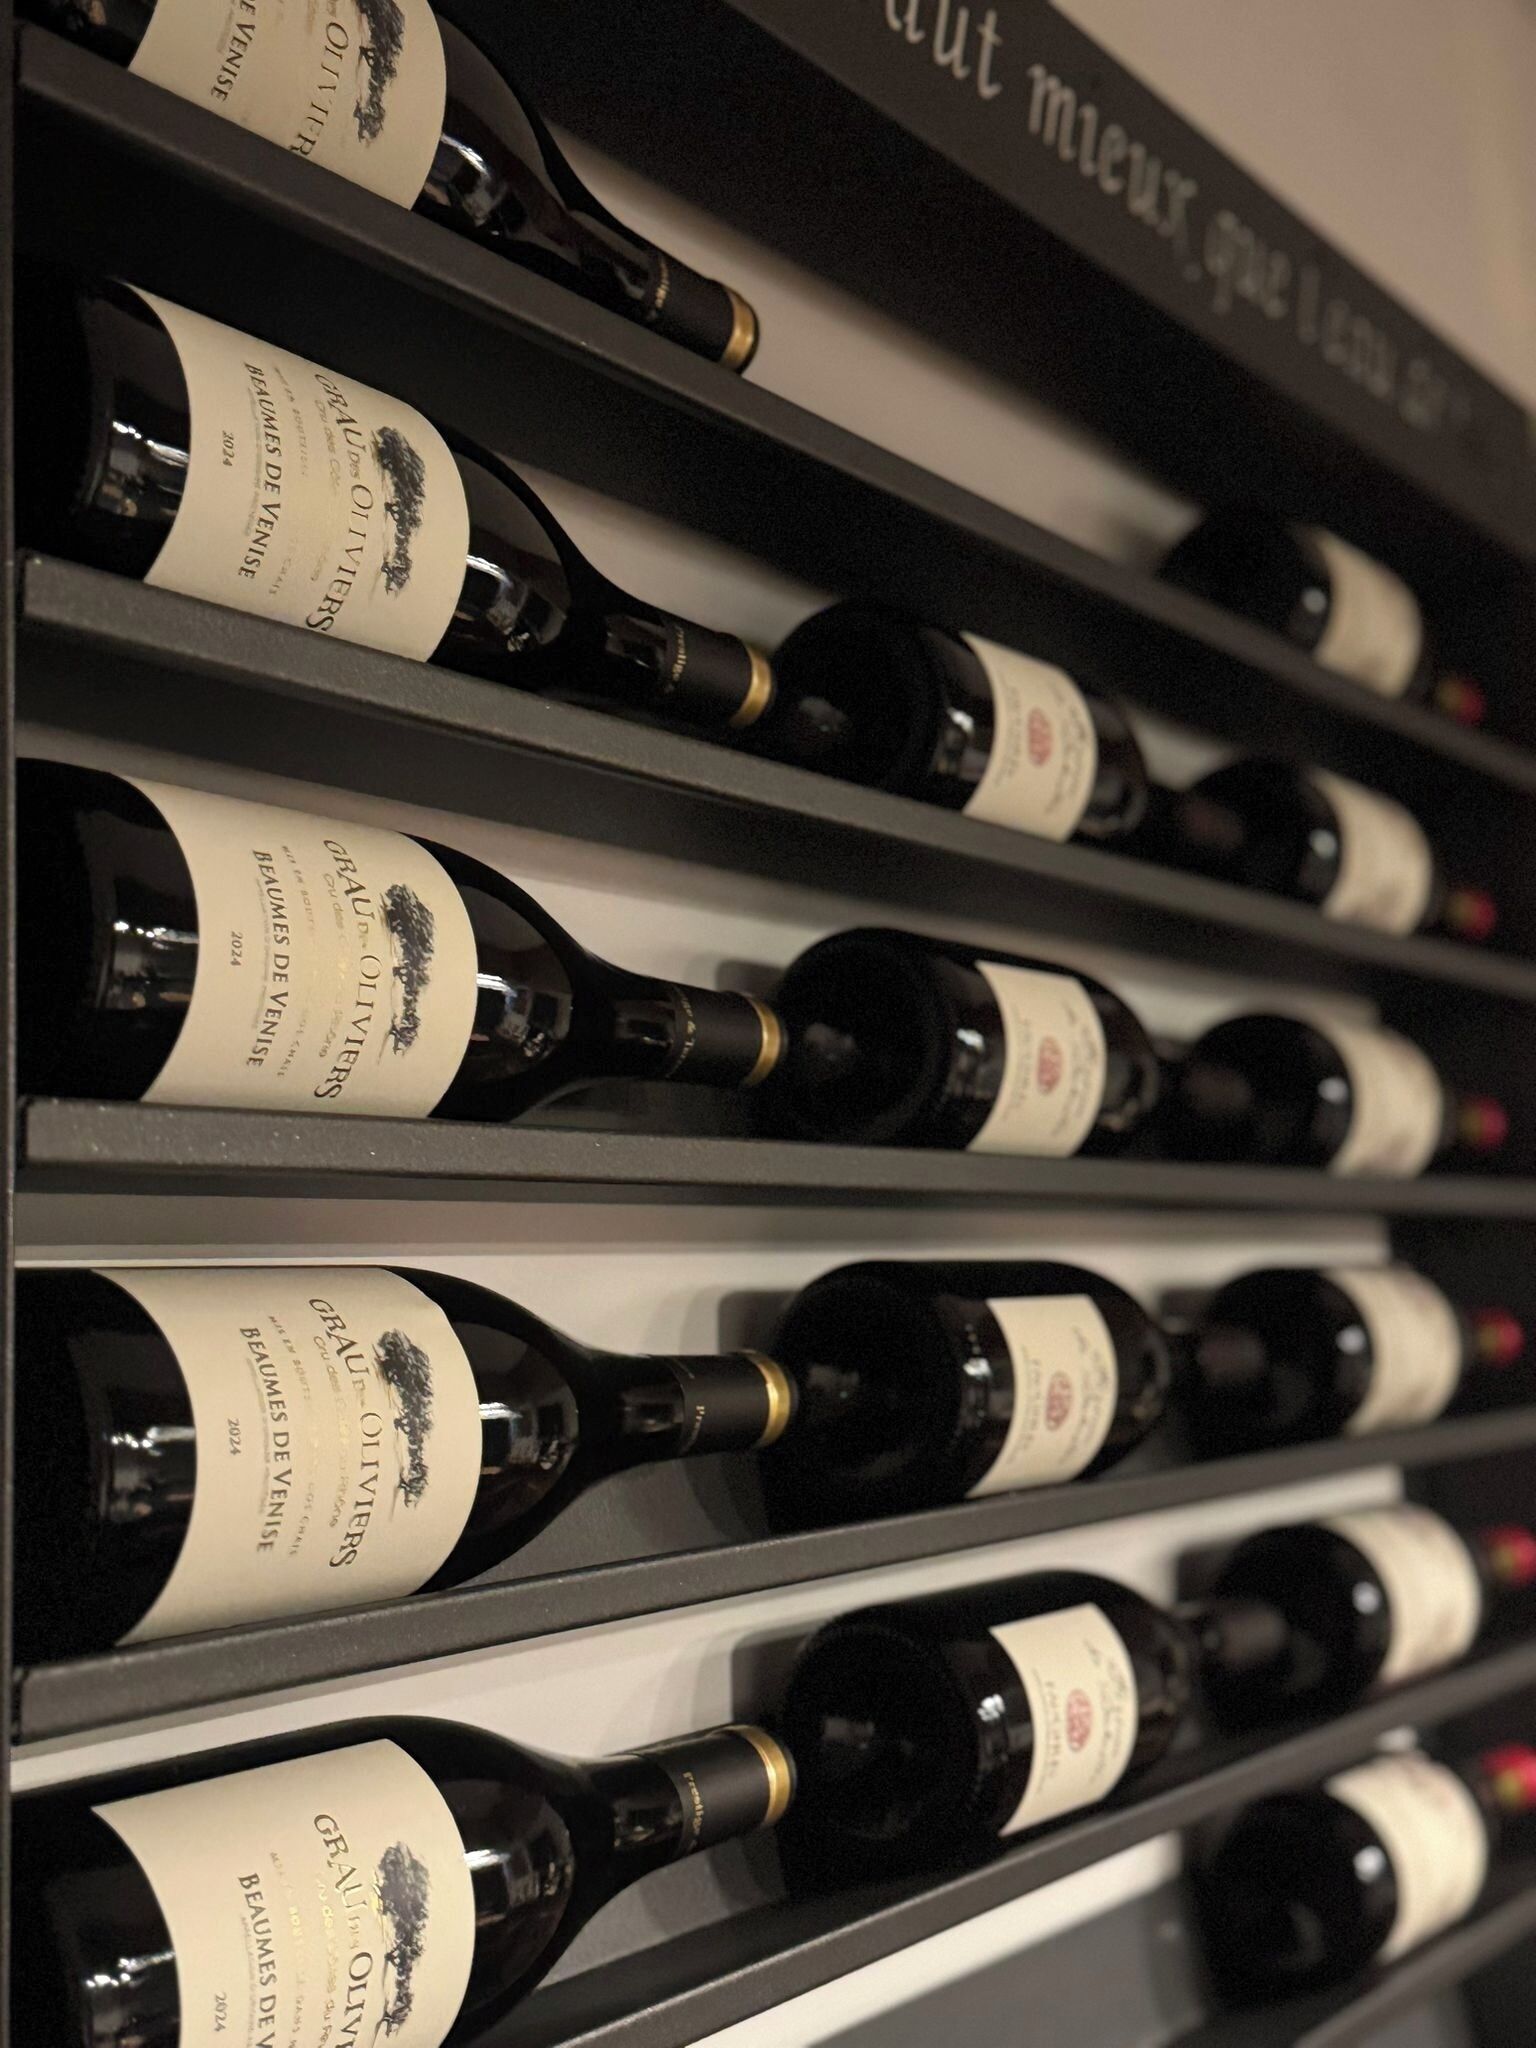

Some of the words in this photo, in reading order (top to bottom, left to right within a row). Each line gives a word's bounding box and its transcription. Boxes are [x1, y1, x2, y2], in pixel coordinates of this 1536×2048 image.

[210, 22, 256, 102] VENISE
[1027, 62, 1200, 258] mieux
[221, 429, 236, 468] 2024
[243, 361, 283, 458] BEAUMES
[314, 372, 367, 454] GRAU
[263, 462, 283, 496] DE
[237, 501, 282, 580] VENISE
[305, 483, 374, 632] OLIVIERS
[252, 849, 291, 947] BEAUMES
[322, 838, 376, 921] GRAU
[229, 930, 244, 967] 2024
[271, 952, 291, 984] DE
[245, 990, 290, 1068] VENISE
[313, 953, 383, 1100] OLIVIERS
[239, 1326, 290, 1424] BEAUMES
[308, 1297, 371, 1376] GRAU
[226, 1418, 242, 1457] 2024
[271, 1430, 291, 1463] DE
[255, 1468, 293, 1554] VENISE
[328, 1411, 383, 1569] OLIVIERS
[312, 1813, 369, 1909] GRAU
[237, 1871, 278, 1988] BEAUMES
[213, 1991, 228, 2033] 2024
[256, 1993, 277, 2030] DE
